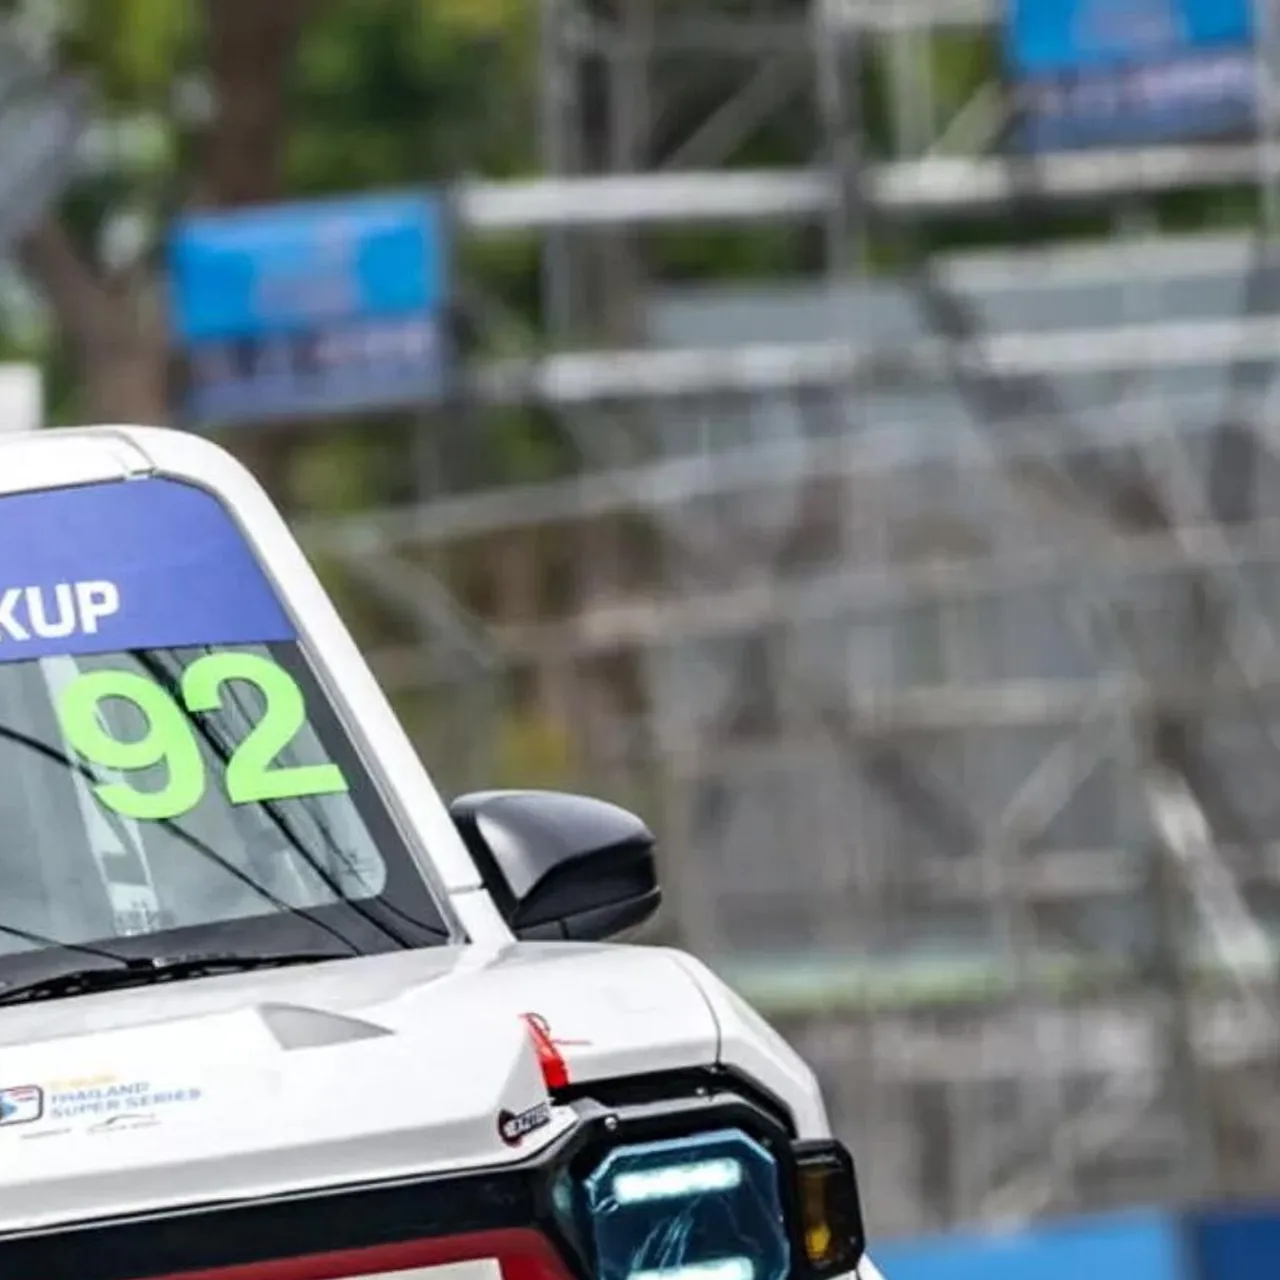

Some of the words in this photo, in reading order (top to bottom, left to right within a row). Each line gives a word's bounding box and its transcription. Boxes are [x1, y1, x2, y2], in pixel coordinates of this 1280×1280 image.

[60, 652, 350, 820] 92
[50, 1081, 151, 1104] THAILAND
[50, 1095, 122, 1119] SUPER
[124, 1088, 202, 1110] SERIES
